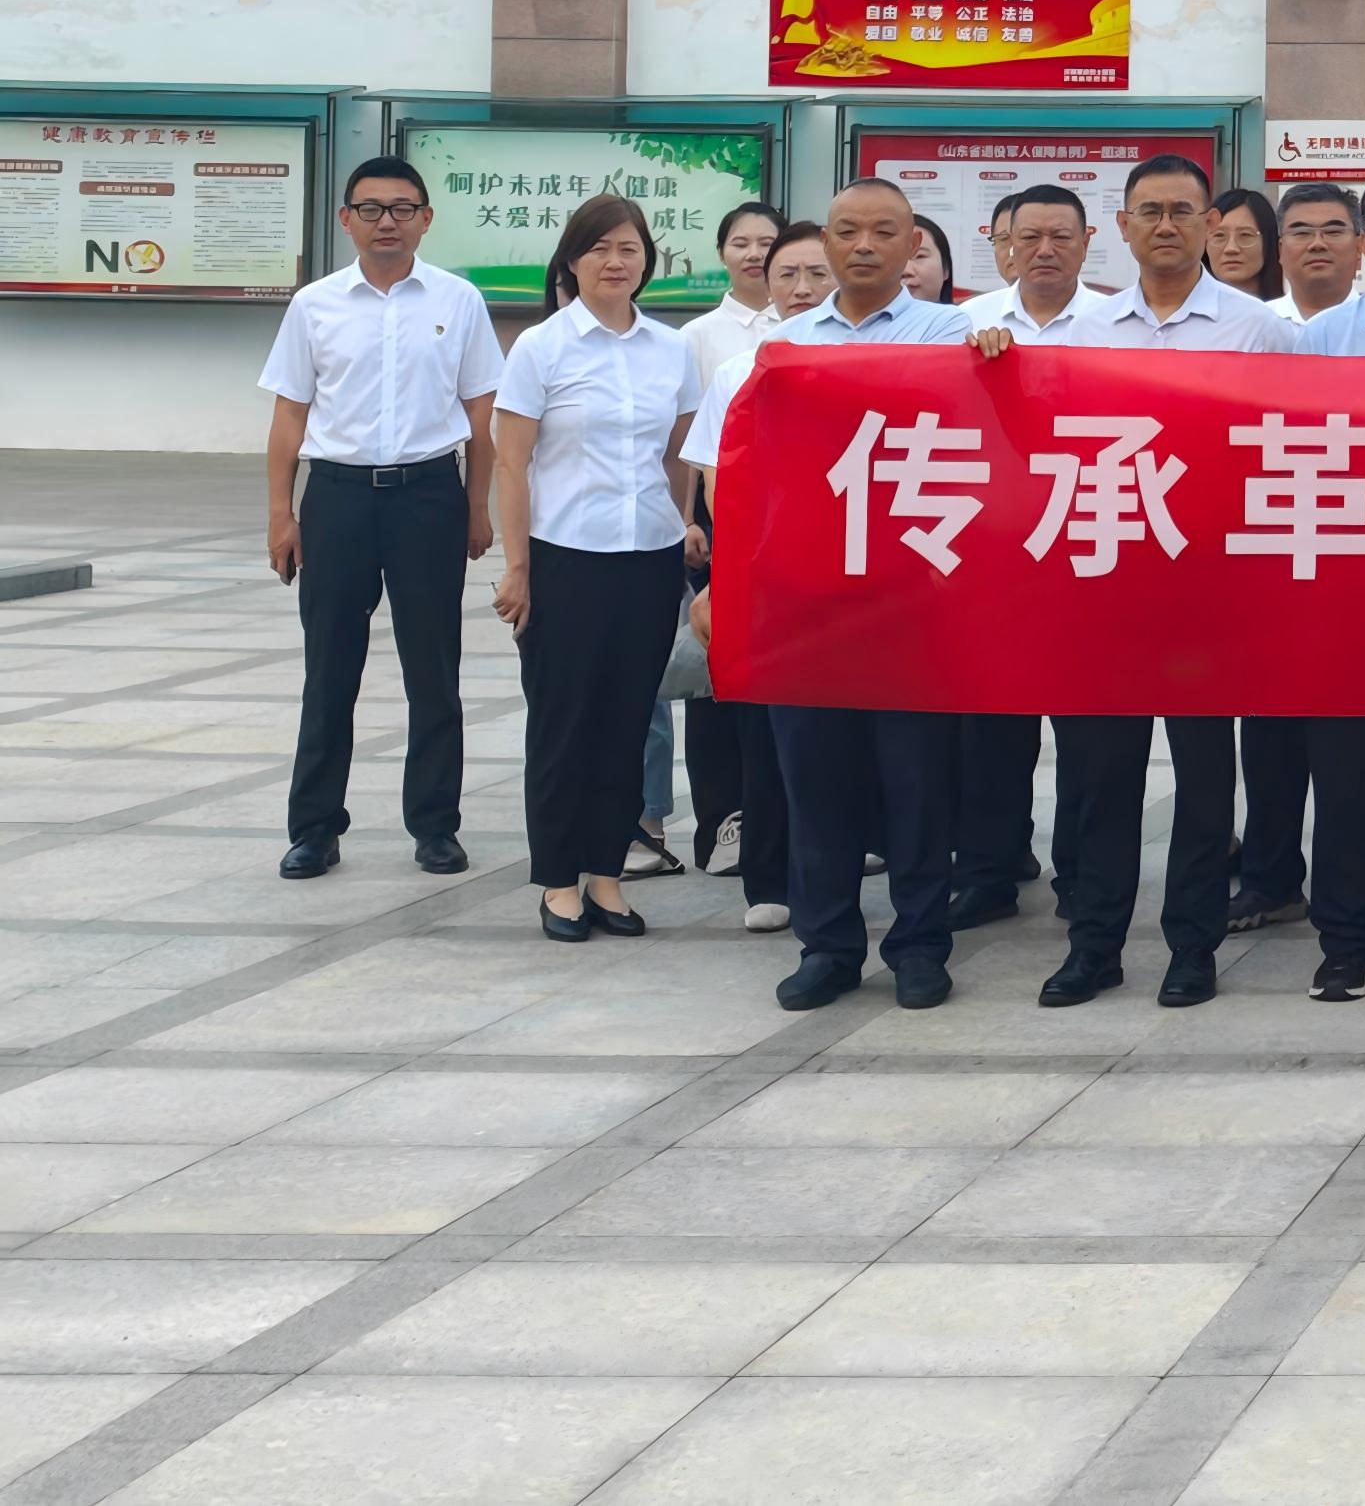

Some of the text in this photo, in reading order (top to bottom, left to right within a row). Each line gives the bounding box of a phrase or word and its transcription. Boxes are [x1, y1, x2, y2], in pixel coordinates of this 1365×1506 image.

[866, 4, 898, 20] 自由
[955, 6, 989, 21] 公正
[1001, 6, 1034, 22] 法治
[956, 26, 989, 42] 诚信
[449, 171, 678, 199] 呵护未成年人健康
[476, 205, 705, 230] 关爱未成长
